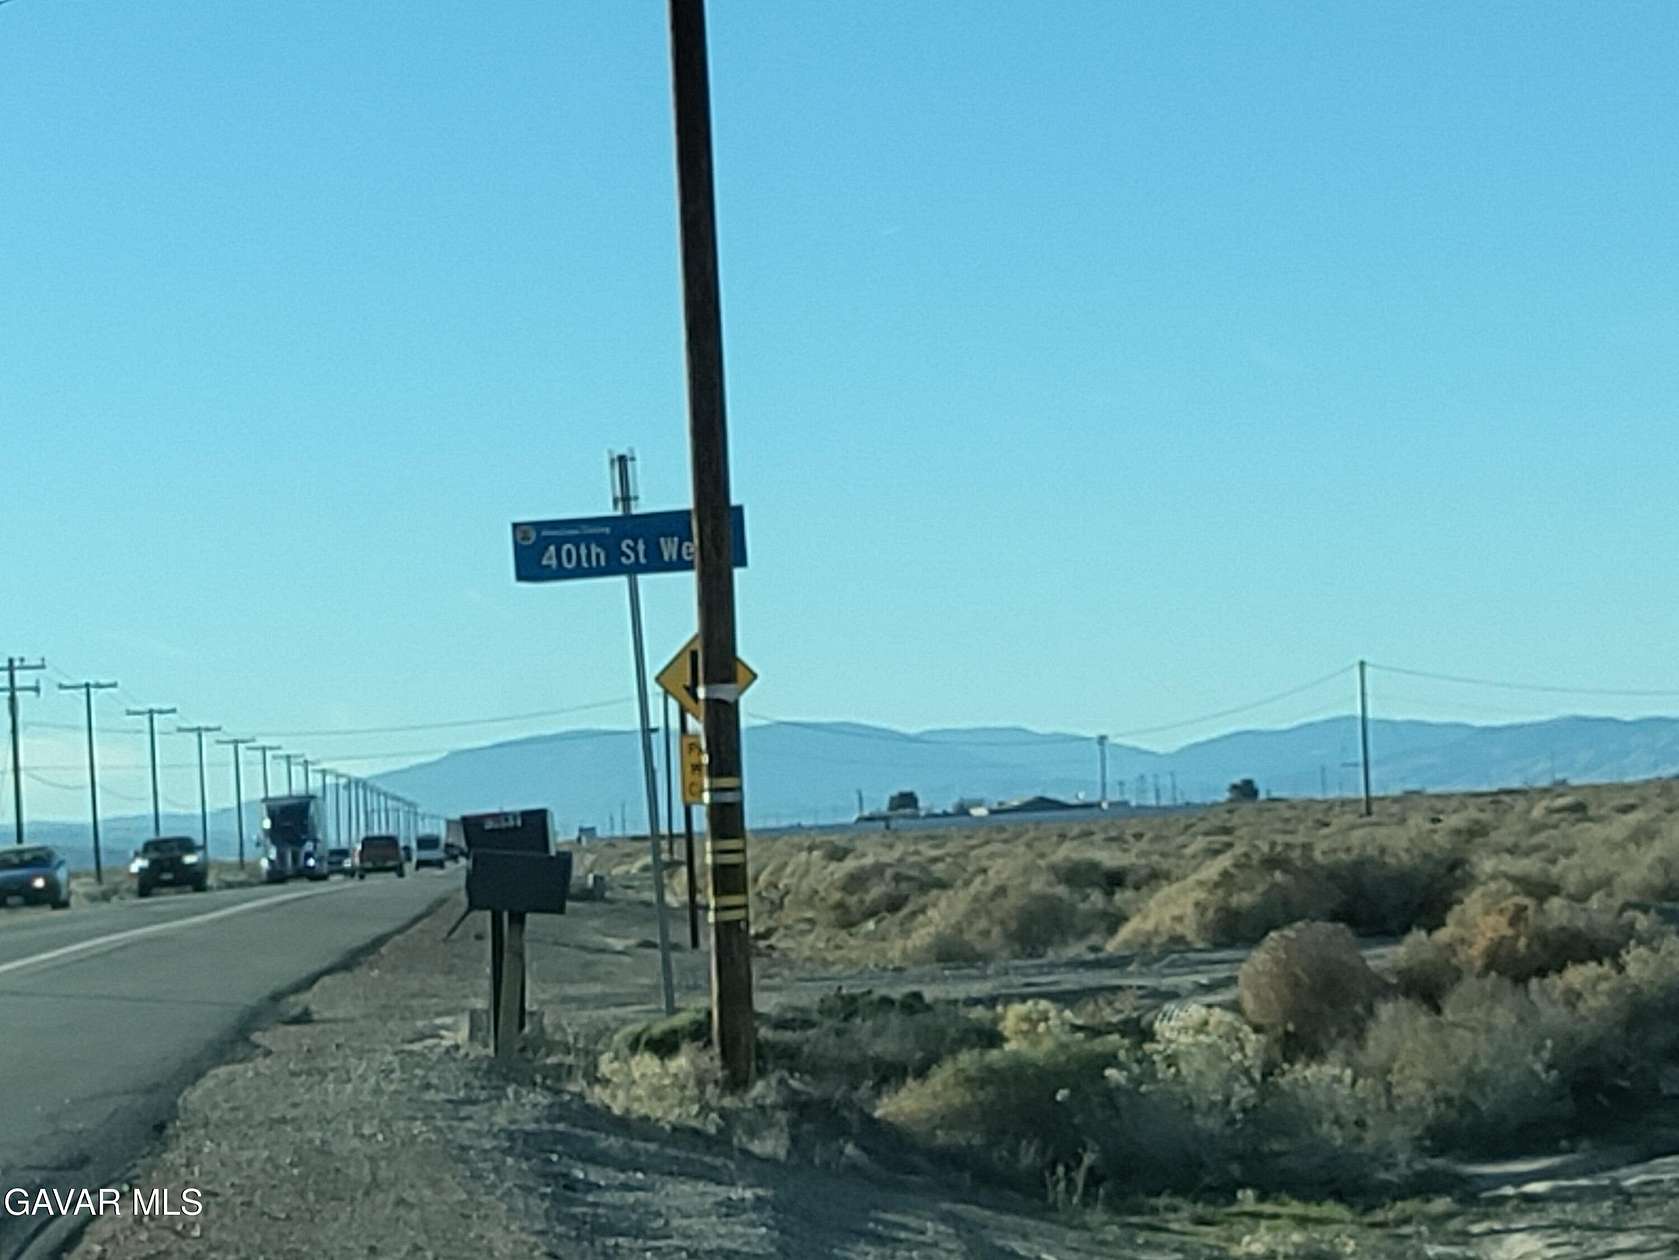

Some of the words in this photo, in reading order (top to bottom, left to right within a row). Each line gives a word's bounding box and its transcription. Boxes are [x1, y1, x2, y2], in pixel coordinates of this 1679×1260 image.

[541, 542, 606, 570] 40th
[620, 538, 647, 564] St
[659, 536, 695, 562] We
